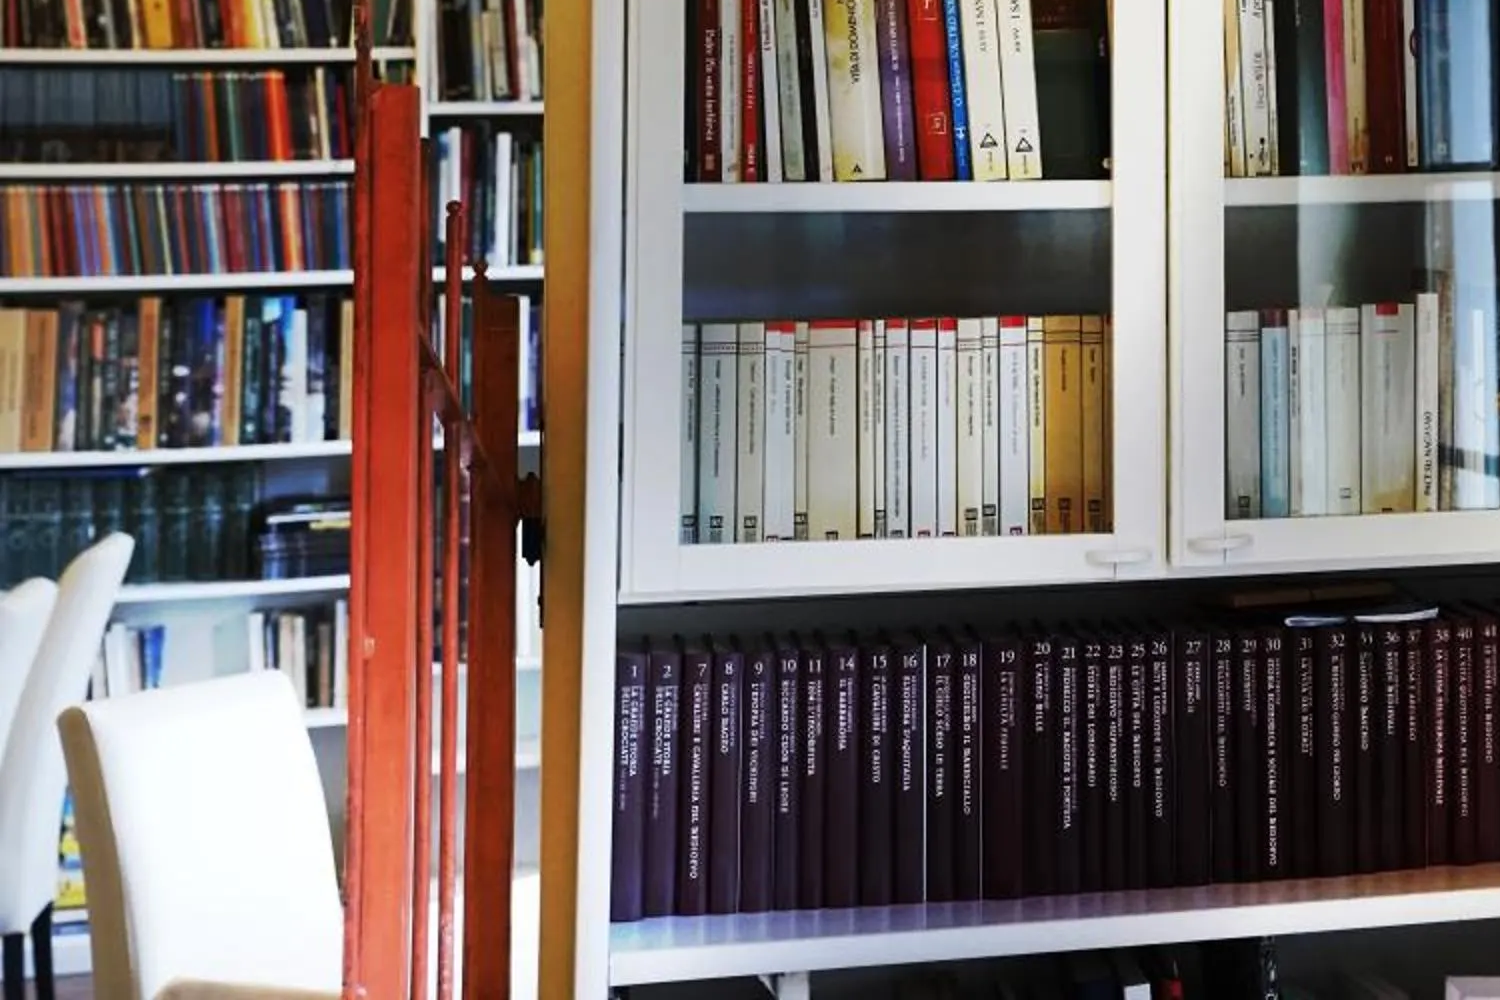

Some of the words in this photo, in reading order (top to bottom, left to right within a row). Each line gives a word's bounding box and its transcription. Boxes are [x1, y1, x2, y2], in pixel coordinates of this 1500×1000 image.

[850, 52, 859, 61] DI
[850, 64, 860, 84] VITA
[1457, 627, 1472, 640] 40
[1483, 625, 1497, 637] 41
[1216, 640, 1231, 653] 28
[1243, 640, 1257, 653] 29
[1266, 639, 1281, 652] 30
[1299, 638, 1312, 651] 31
[1331, 633, 1346, 648] 32
[1035, 643, 1051, 655] 20
[1062, 648, 1075, 659] 21
[1085, 645, 1101, 657] 22
[1108, 645, 1123, 659] 23
[1132, 644, 1146, 657] 25
[1152, 642, 1167, 655] 26
[1186, 641, 1201, 655] 27
[840, 655, 855, 671] 14
[873, 656, 887, 669] 15
[903, 656, 918, 668] 16
[937, 654, 951, 668] 17
[963, 654, 977, 667] 18
[1001, 650, 1015, 664] 19
[632, 666, 637, 677] 1
[663, 666, 672, 679] 2
[698, 664, 707, 677] 7
[725, 663, 733, 674] 8
[754, 662, 764, 675] 9
[782, 660, 797, 673] 10
[809, 660, 821, 673] 11
[721, 684, 729, 715] CARLO
[872, 750, 881, 783] CRISTO
